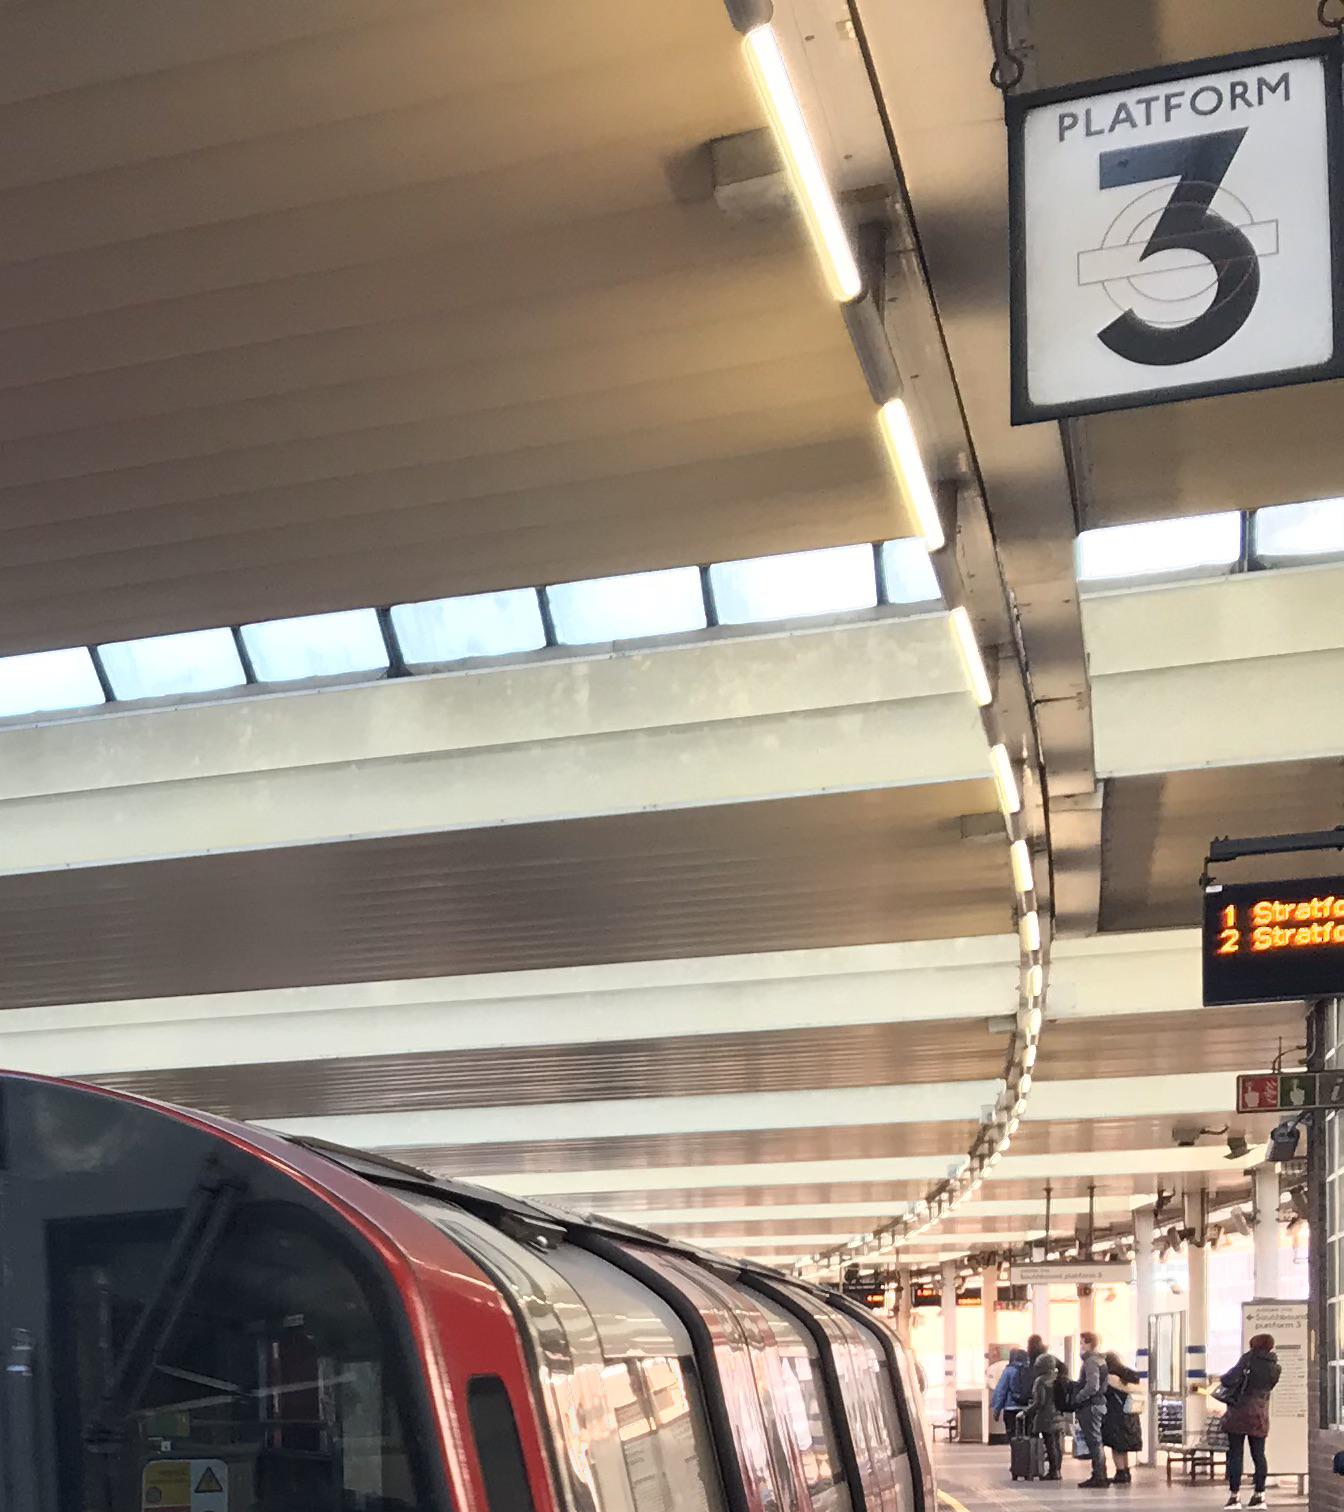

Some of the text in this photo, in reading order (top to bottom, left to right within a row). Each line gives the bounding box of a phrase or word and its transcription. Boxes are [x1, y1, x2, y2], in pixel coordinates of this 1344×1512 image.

[1058, 72, 1291, 142] PLATFORM
[1097, 126, 1261, 365] 3
[1223, 903, 1238, 927] 1
[1218, 928, 1240, 954] 2
